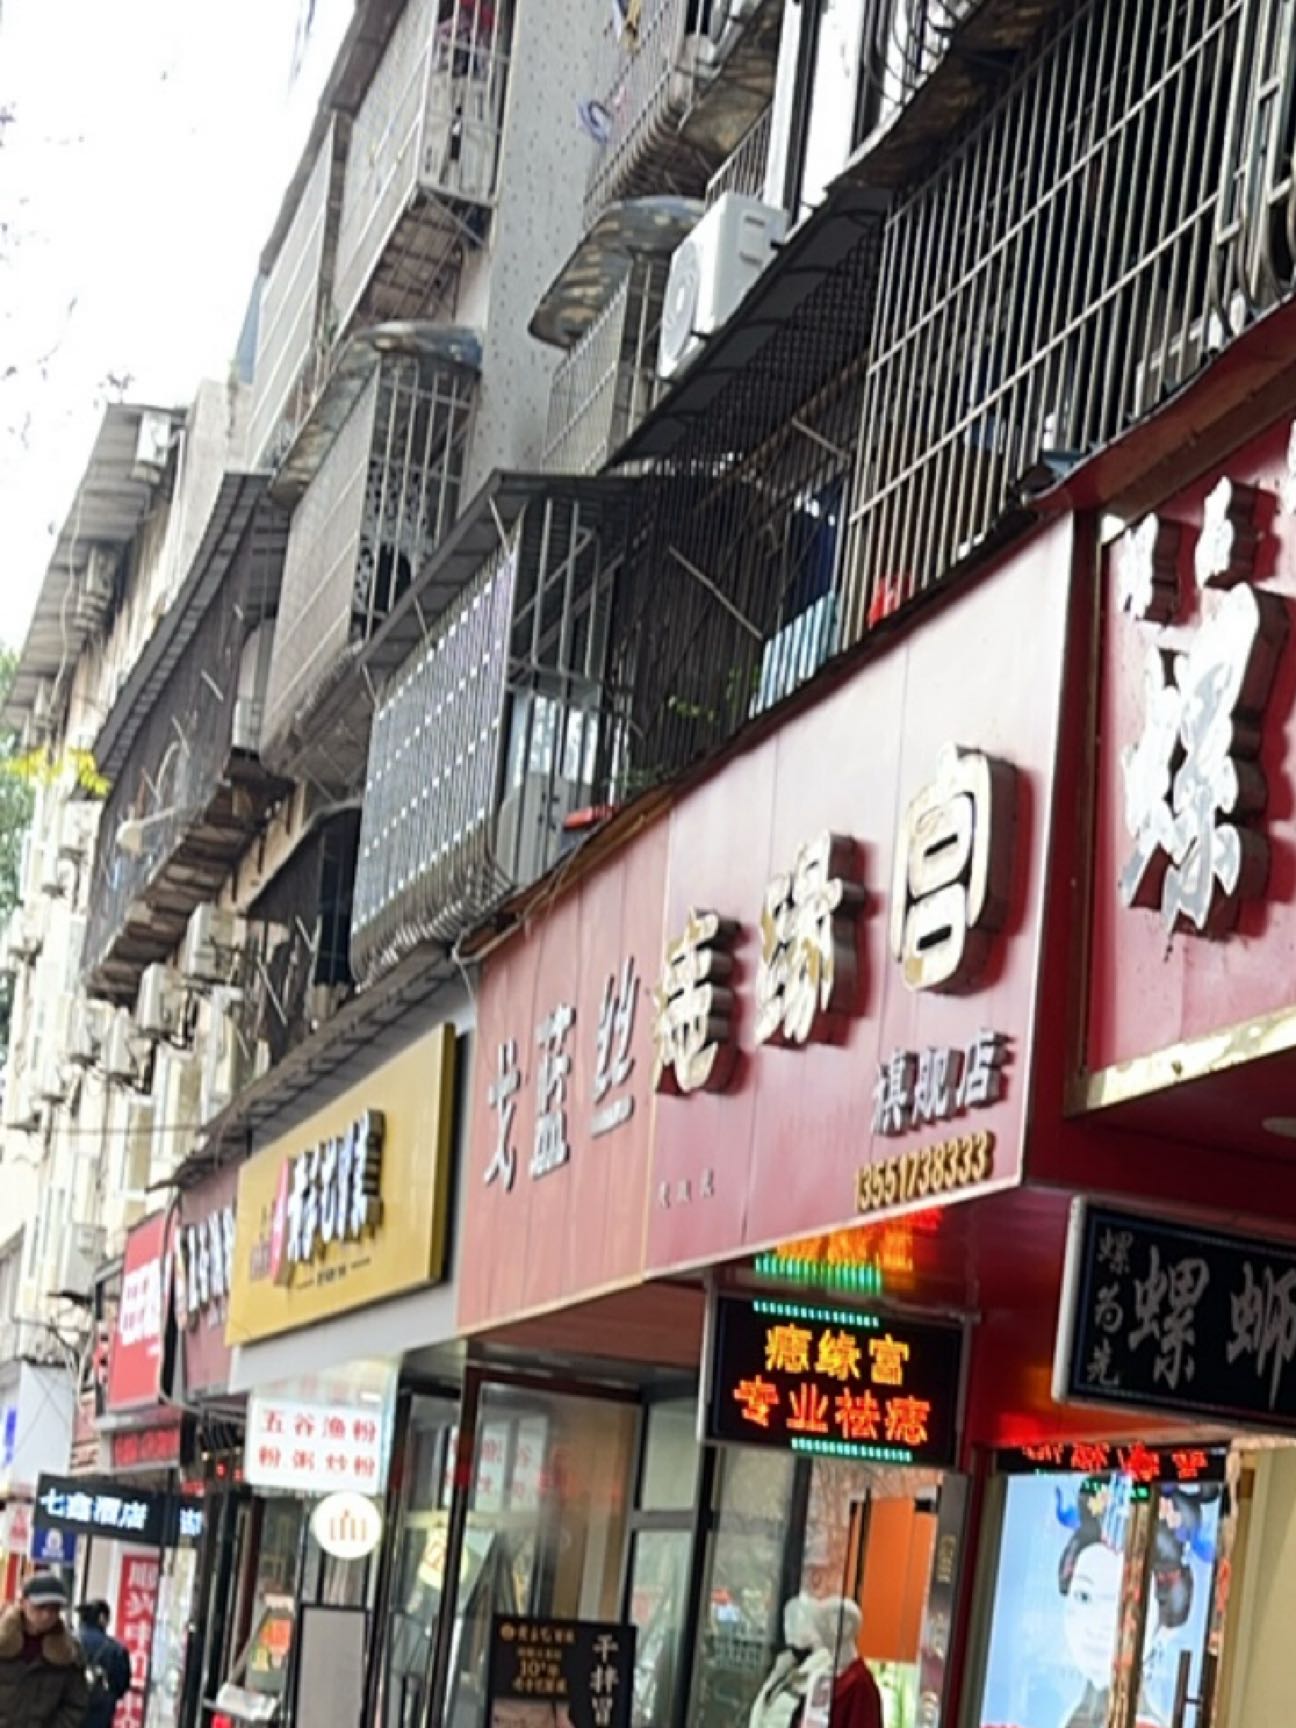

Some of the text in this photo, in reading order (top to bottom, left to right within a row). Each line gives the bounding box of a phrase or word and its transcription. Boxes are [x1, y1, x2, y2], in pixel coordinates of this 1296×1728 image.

[871, 1027, 1000, 1136] 旗舰店
[264, 1410, 376, 1443] 五谷渔粉
[734, 1375, 930, 1446] 专业祛痣
